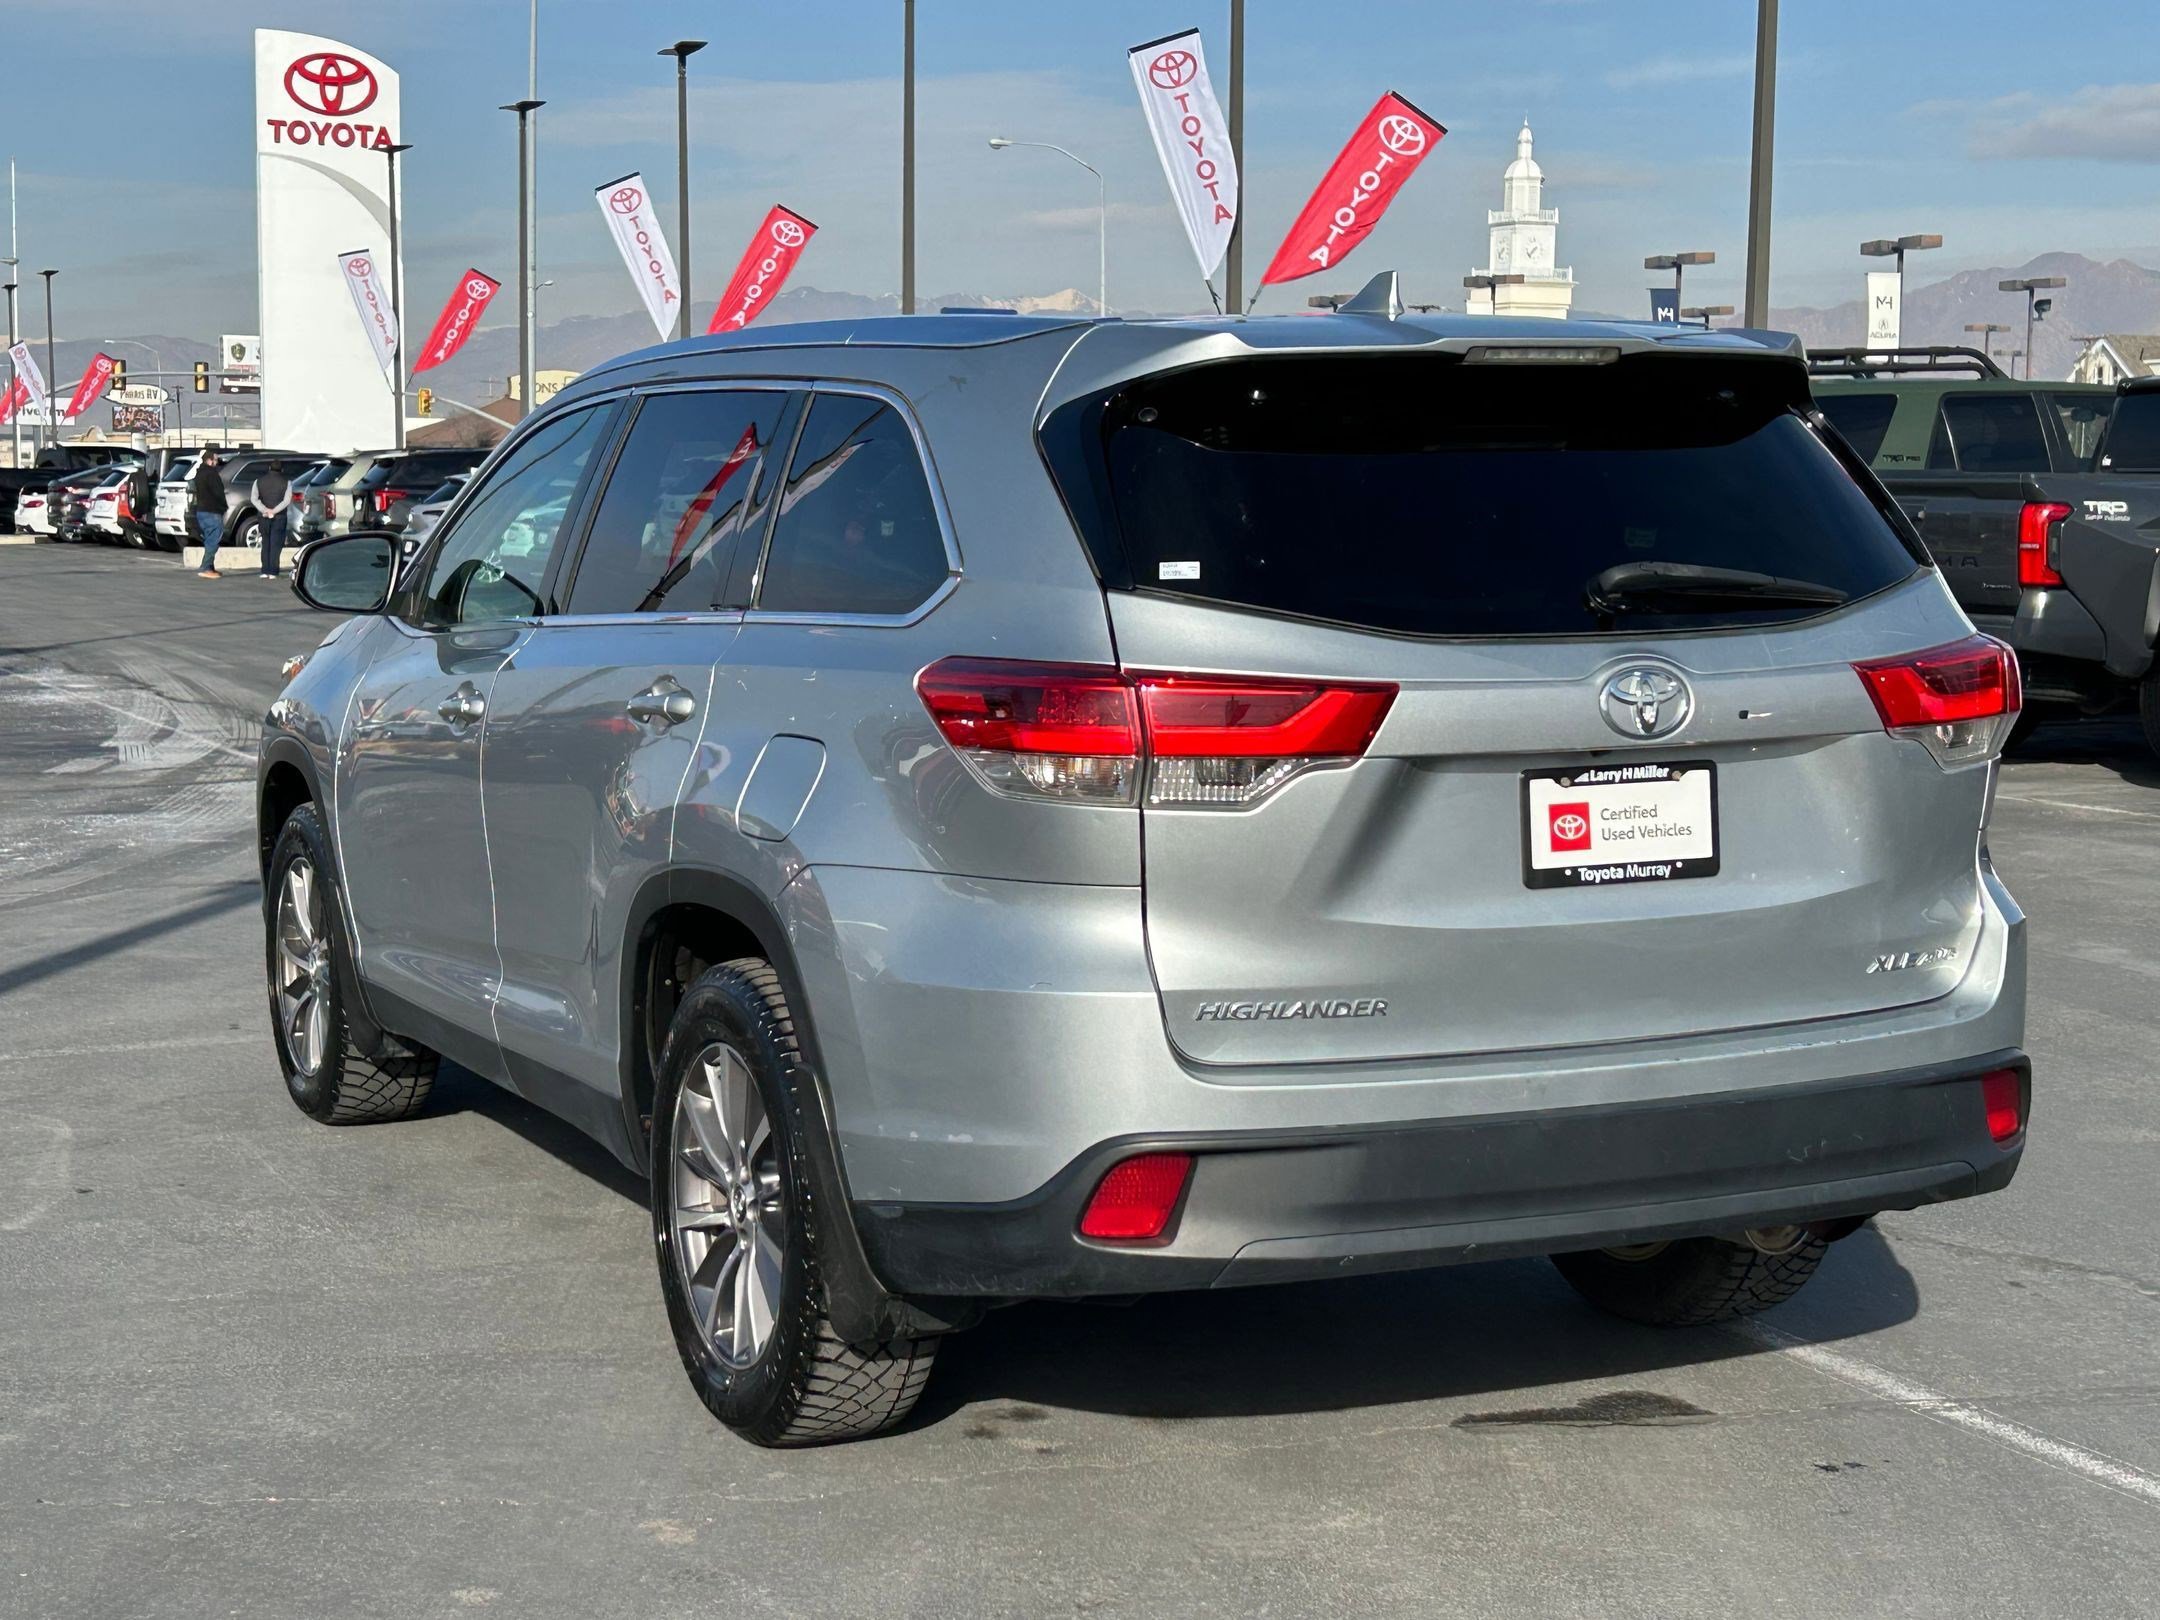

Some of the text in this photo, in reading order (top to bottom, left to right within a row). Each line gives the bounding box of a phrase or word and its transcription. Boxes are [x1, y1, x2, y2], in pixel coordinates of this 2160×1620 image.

[267, 119, 393, 149] TOYOTA
[1174, 93, 1233, 225] TOYOTA
[1308, 151, 1395, 268] TOYOTA
[629, 216, 677, 304] TOYOTA
[732, 245, 785, 327] TOYOTA
[362, 279, 394, 346] TOYOTA
[434, 299, 475, 362] TOYOTA
[2083, 501, 2128, 515] TRD
[1590, 765, 1669, 784] Larry H Miller
[1600, 804, 1658, 821] Certified
[1601, 823, 1692, 841] Used Vehicles
[1578, 864, 1672, 883] Toyota Murray
[1195, 999, 1389, 1021] HIGHLANDER
